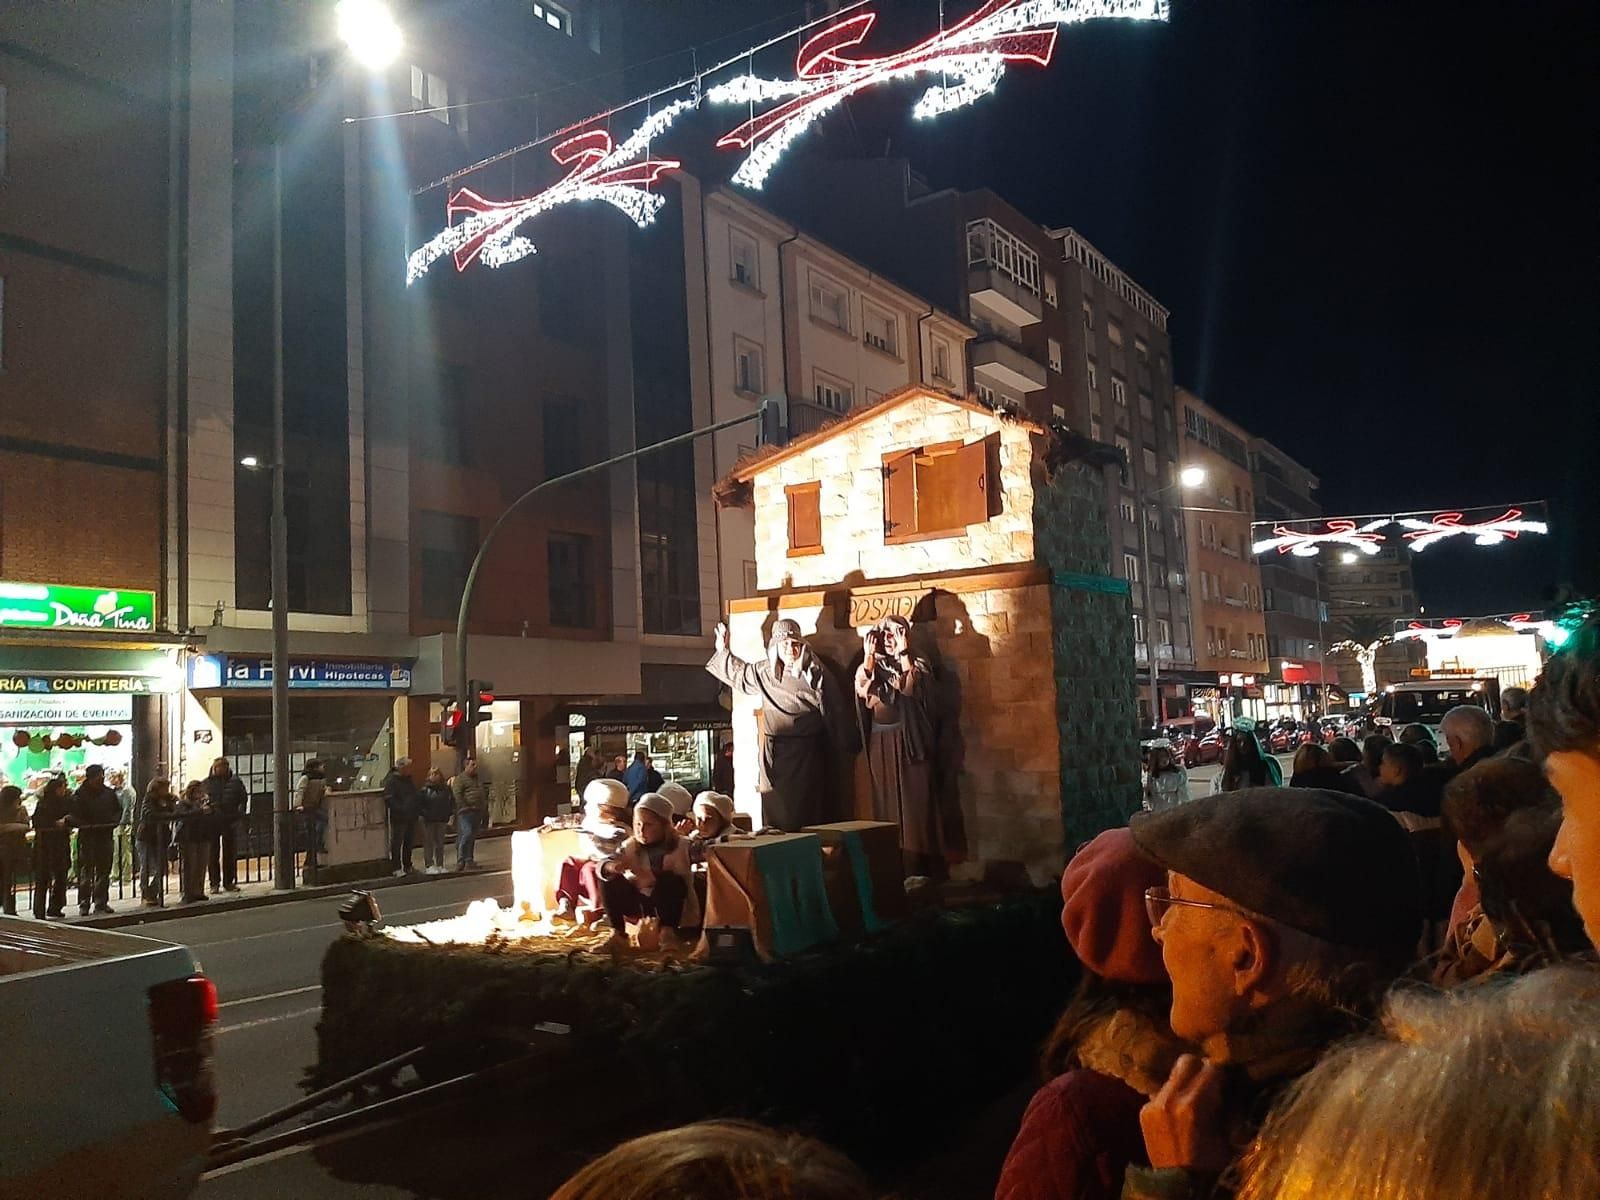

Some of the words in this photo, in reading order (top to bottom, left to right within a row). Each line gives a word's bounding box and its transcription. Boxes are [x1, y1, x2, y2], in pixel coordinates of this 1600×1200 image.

[850, 595, 918, 622] POSAD
[105, 606, 150, 629] Tina
[259, 659, 316, 680] Frvi
[324, 671, 384, 681] Hipotecas
[52, 677, 144, 691] CONFITERÍA
[65, 710, 79, 719] DE
[82, 709, 128, 718] EVEN
